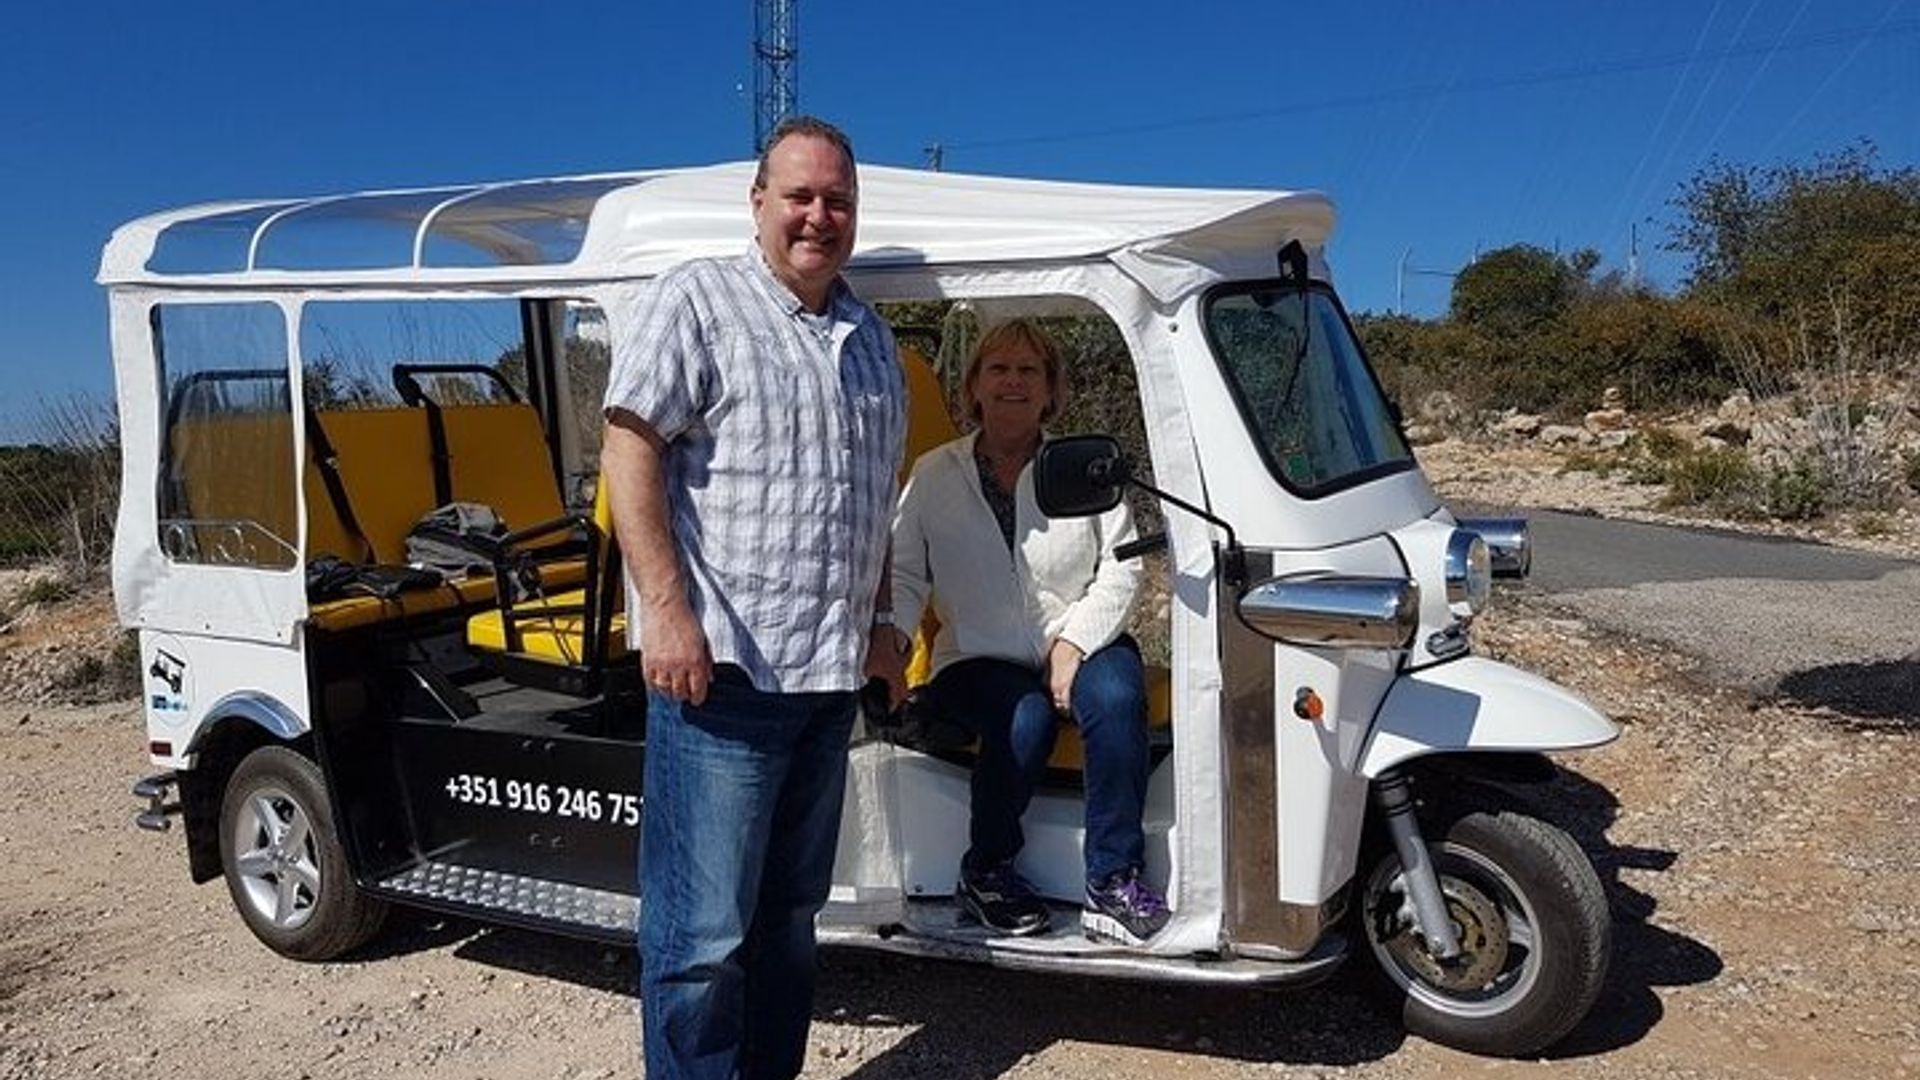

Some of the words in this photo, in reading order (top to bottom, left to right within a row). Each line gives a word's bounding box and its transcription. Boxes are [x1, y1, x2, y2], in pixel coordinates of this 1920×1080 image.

[446, 774, 501, 806] +351
[506, 780, 550, 813] 916
[556, 786, 601, 821] 246
[608, 792, 644, 826] 75
